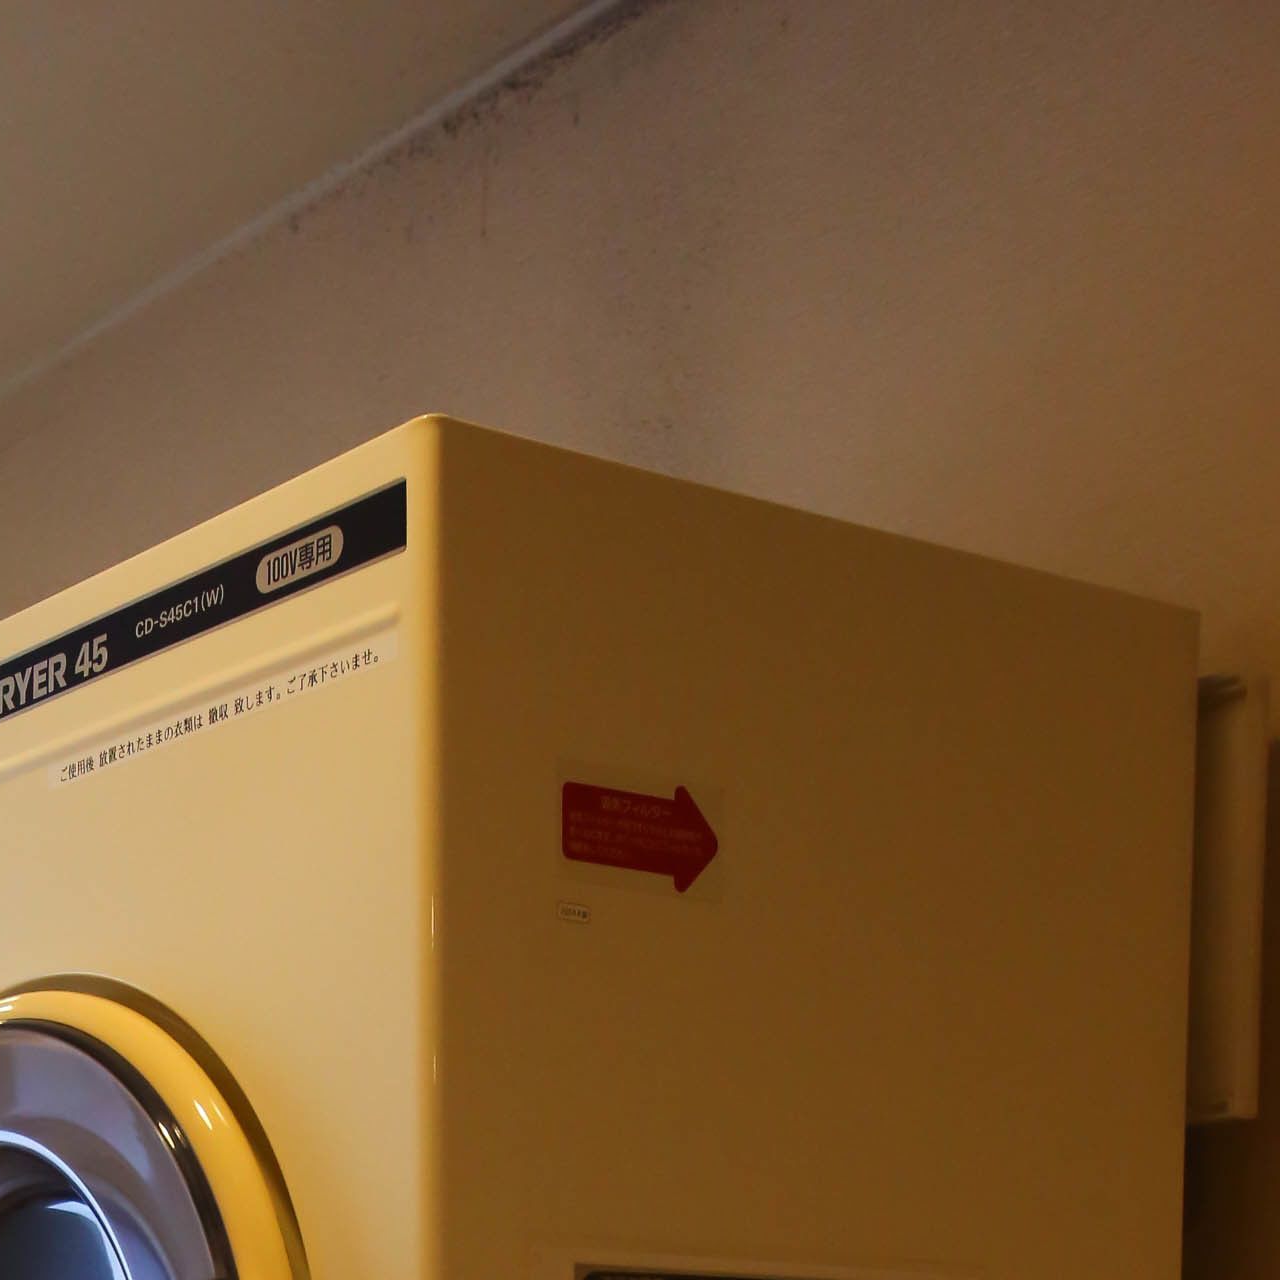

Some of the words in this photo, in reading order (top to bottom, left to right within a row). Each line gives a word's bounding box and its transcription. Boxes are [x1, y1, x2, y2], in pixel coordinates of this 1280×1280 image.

[266, 532, 333, 585] 100V専用
[135, 584, 224, 638] CD-S45C1(W)
[74, 633, 108, 678] 45
[60, 756, 95, 782] ご使用後
[99, 714, 203, 767] 放置されたままの衣類は
